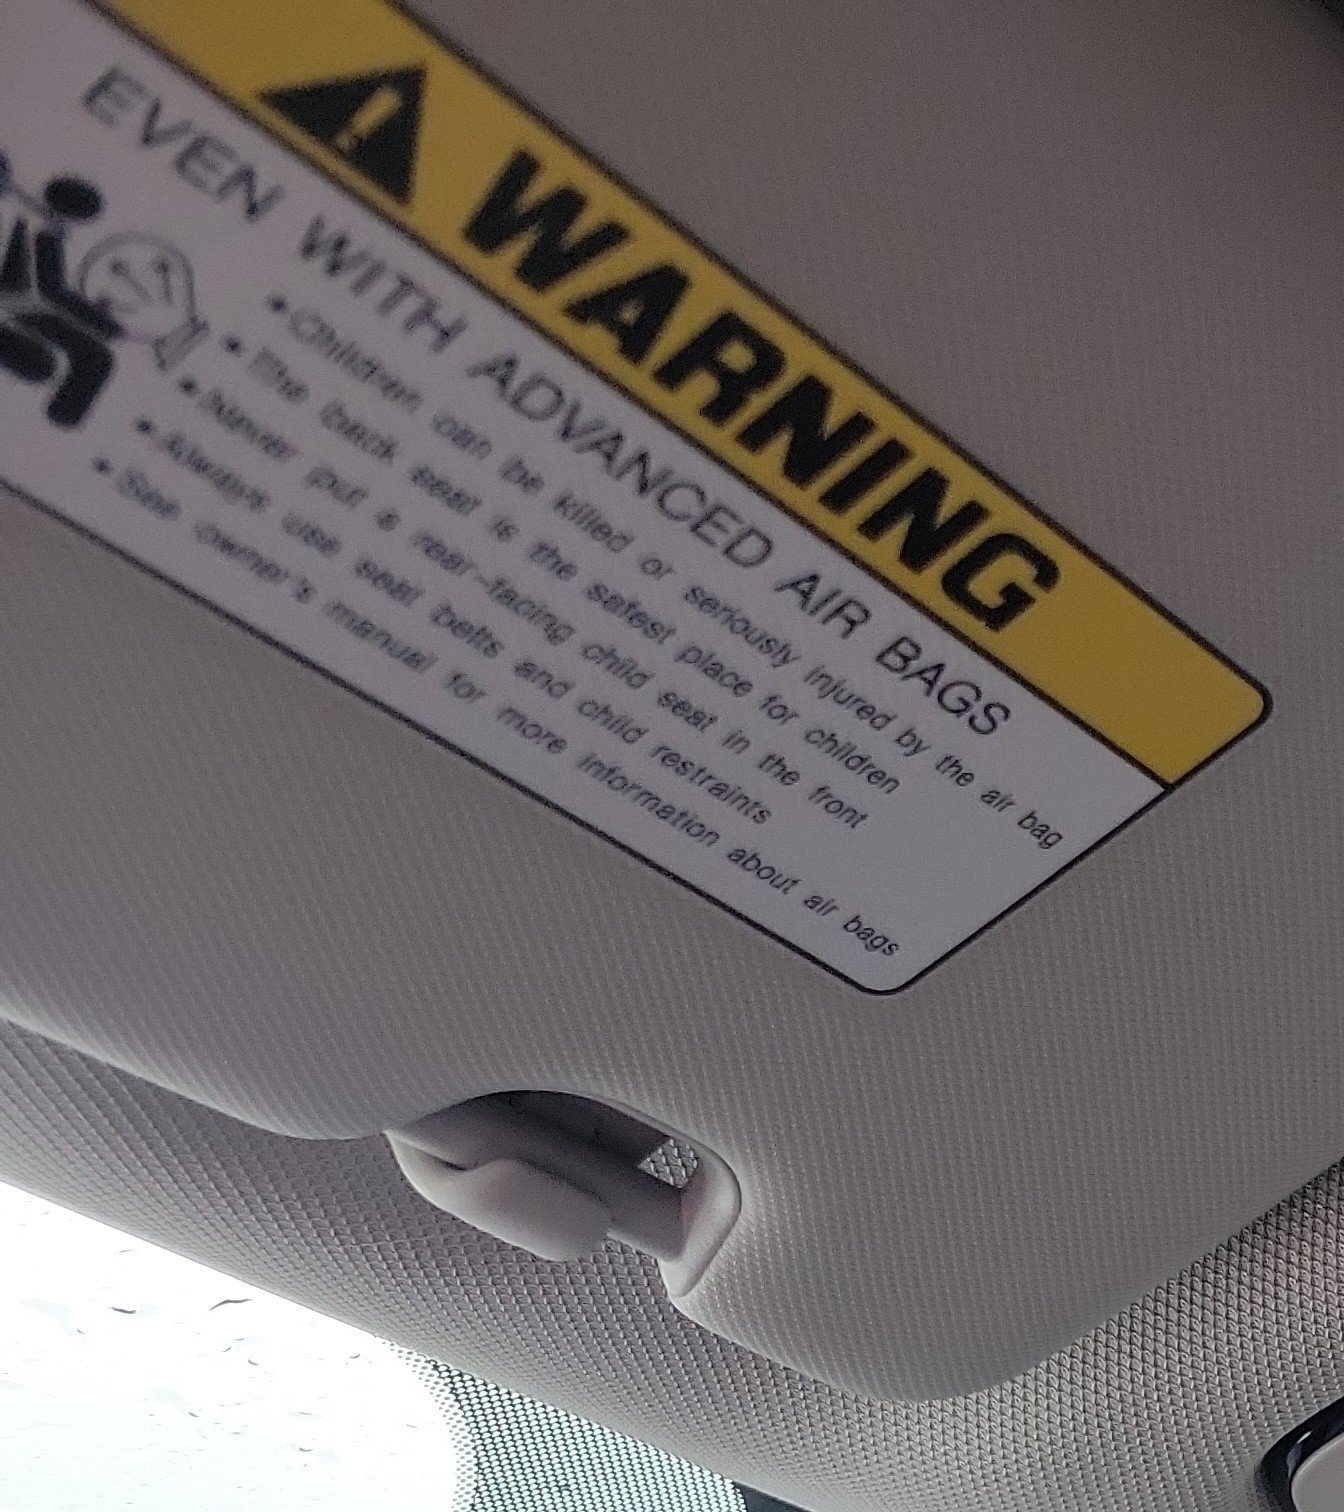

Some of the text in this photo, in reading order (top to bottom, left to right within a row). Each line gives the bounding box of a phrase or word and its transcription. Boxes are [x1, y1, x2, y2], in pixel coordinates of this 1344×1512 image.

[82, 66, 1011, 736] EVEN WITH ADVANCED AIR BAGS
[459, 145, 1061, 633] WARNING
[410, 528, 576, 646] rear-facing
[581, 642, 655, 691] child
[658, 691, 718, 734] seat
[722, 729, 751, 755] in
[758, 752, 800, 787] the
[808, 784, 870, 830] front
[429, 602, 506, 659] belts
[513, 658, 576, 700] and
[577, 699, 650, 745] child
[652, 745, 773, 825] restraints
[489, 514, 520, 542] is
[529, 540, 578, 582] the
[585, 582, 677, 645] safest
[674, 644, 753, 698] place
[759, 694, 799, 726] for
[804, 727, 900, 796] children
[499, 456, 545, 495] be
[554, 491, 634, 553] killed
[640, 556, 677, 581] or
[684, 584, 800, 668] seriously
[804, 665, 897, 732] injured
[895, 727, 932, 758] by
[935, 754, 975, 787] the
[981, 788, 1016, 812] air
[1018, 810, 1062, 850] bag
[446, 671, 490, 706] for
[497, 706, 569, 754] more
[576, 753, 721, 847] information
[726, 847, 803, 896] about
[803, 894, 841, 917] air
[842, 915, 900, 957] bags
